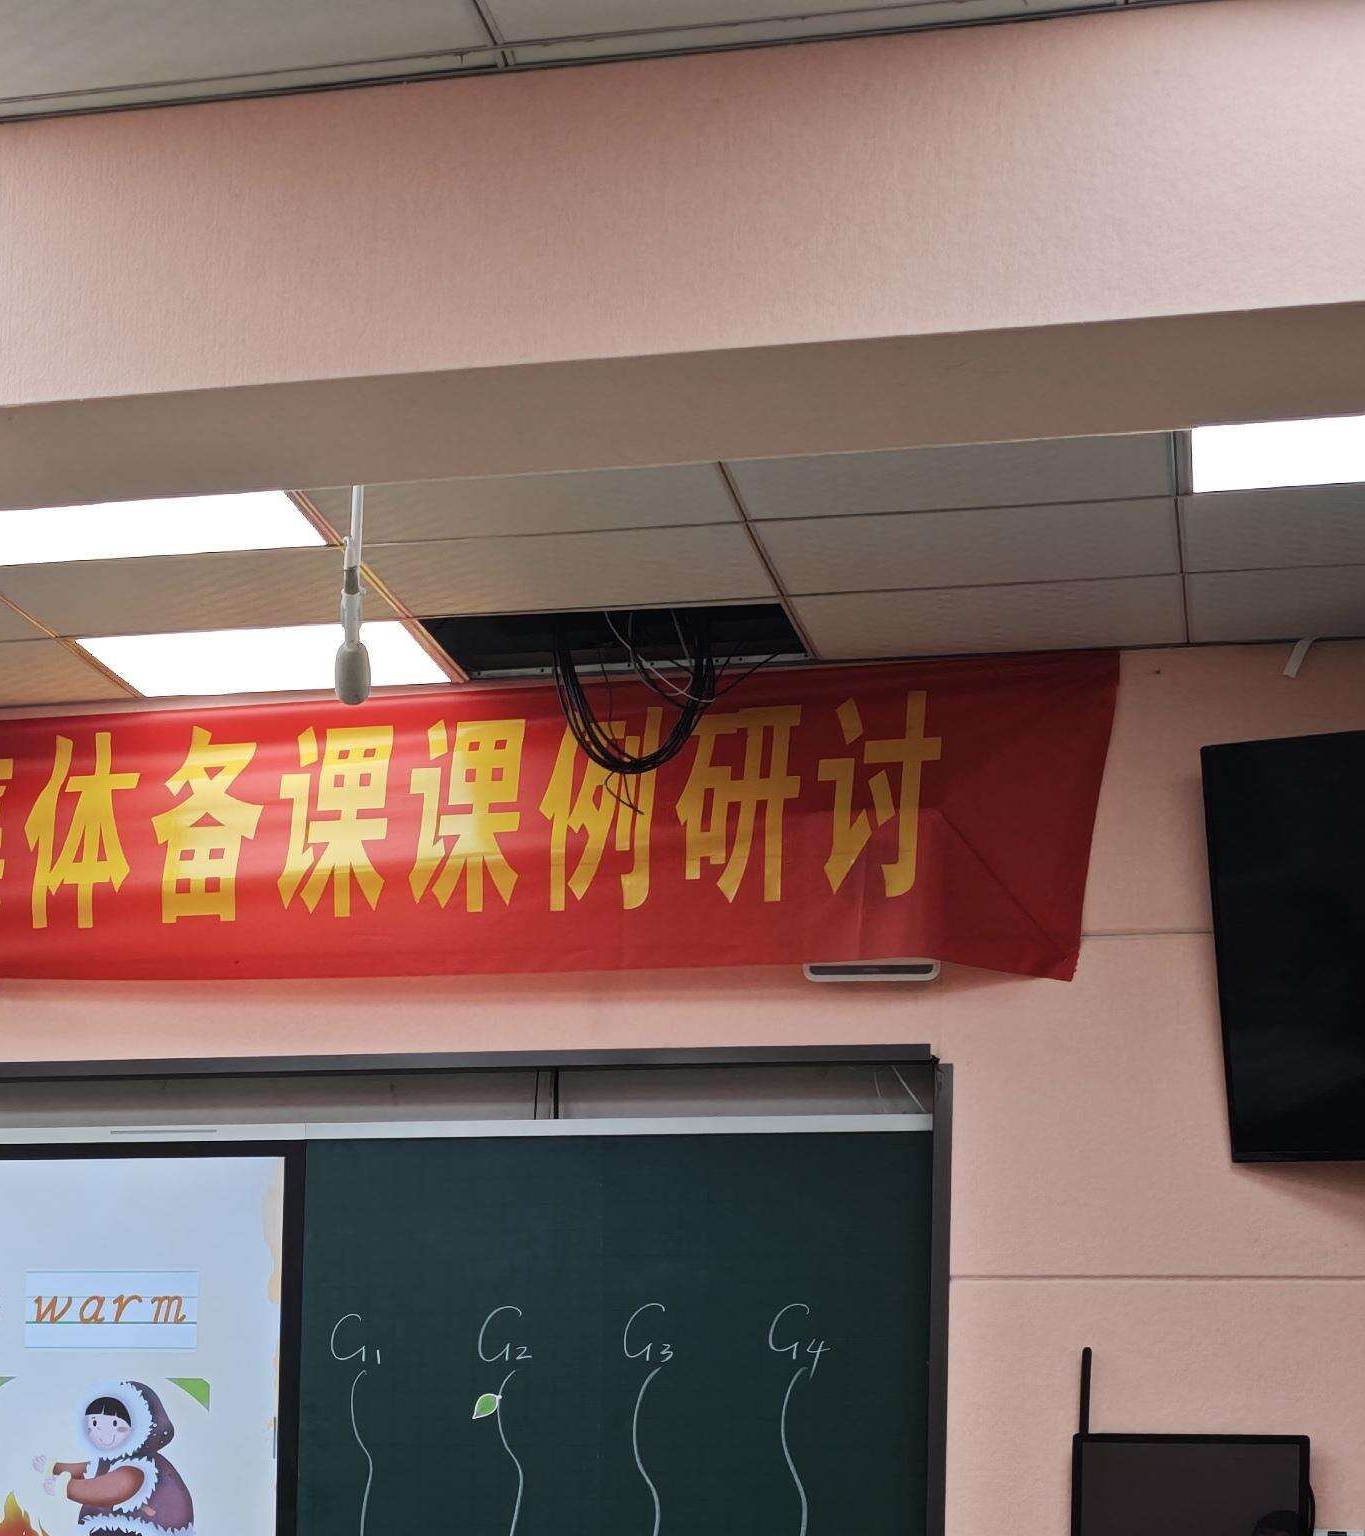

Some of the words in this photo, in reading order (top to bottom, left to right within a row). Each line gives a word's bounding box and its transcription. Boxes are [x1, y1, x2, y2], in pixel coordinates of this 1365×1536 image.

[34, 1294, 187, 1324] warm
[478, 1305, 533, 1362] G2
[623, 1302, 674, 1363] G3
[330, 1313, 381, 1365] G1
[768, 1303, 831, 1381] G4
